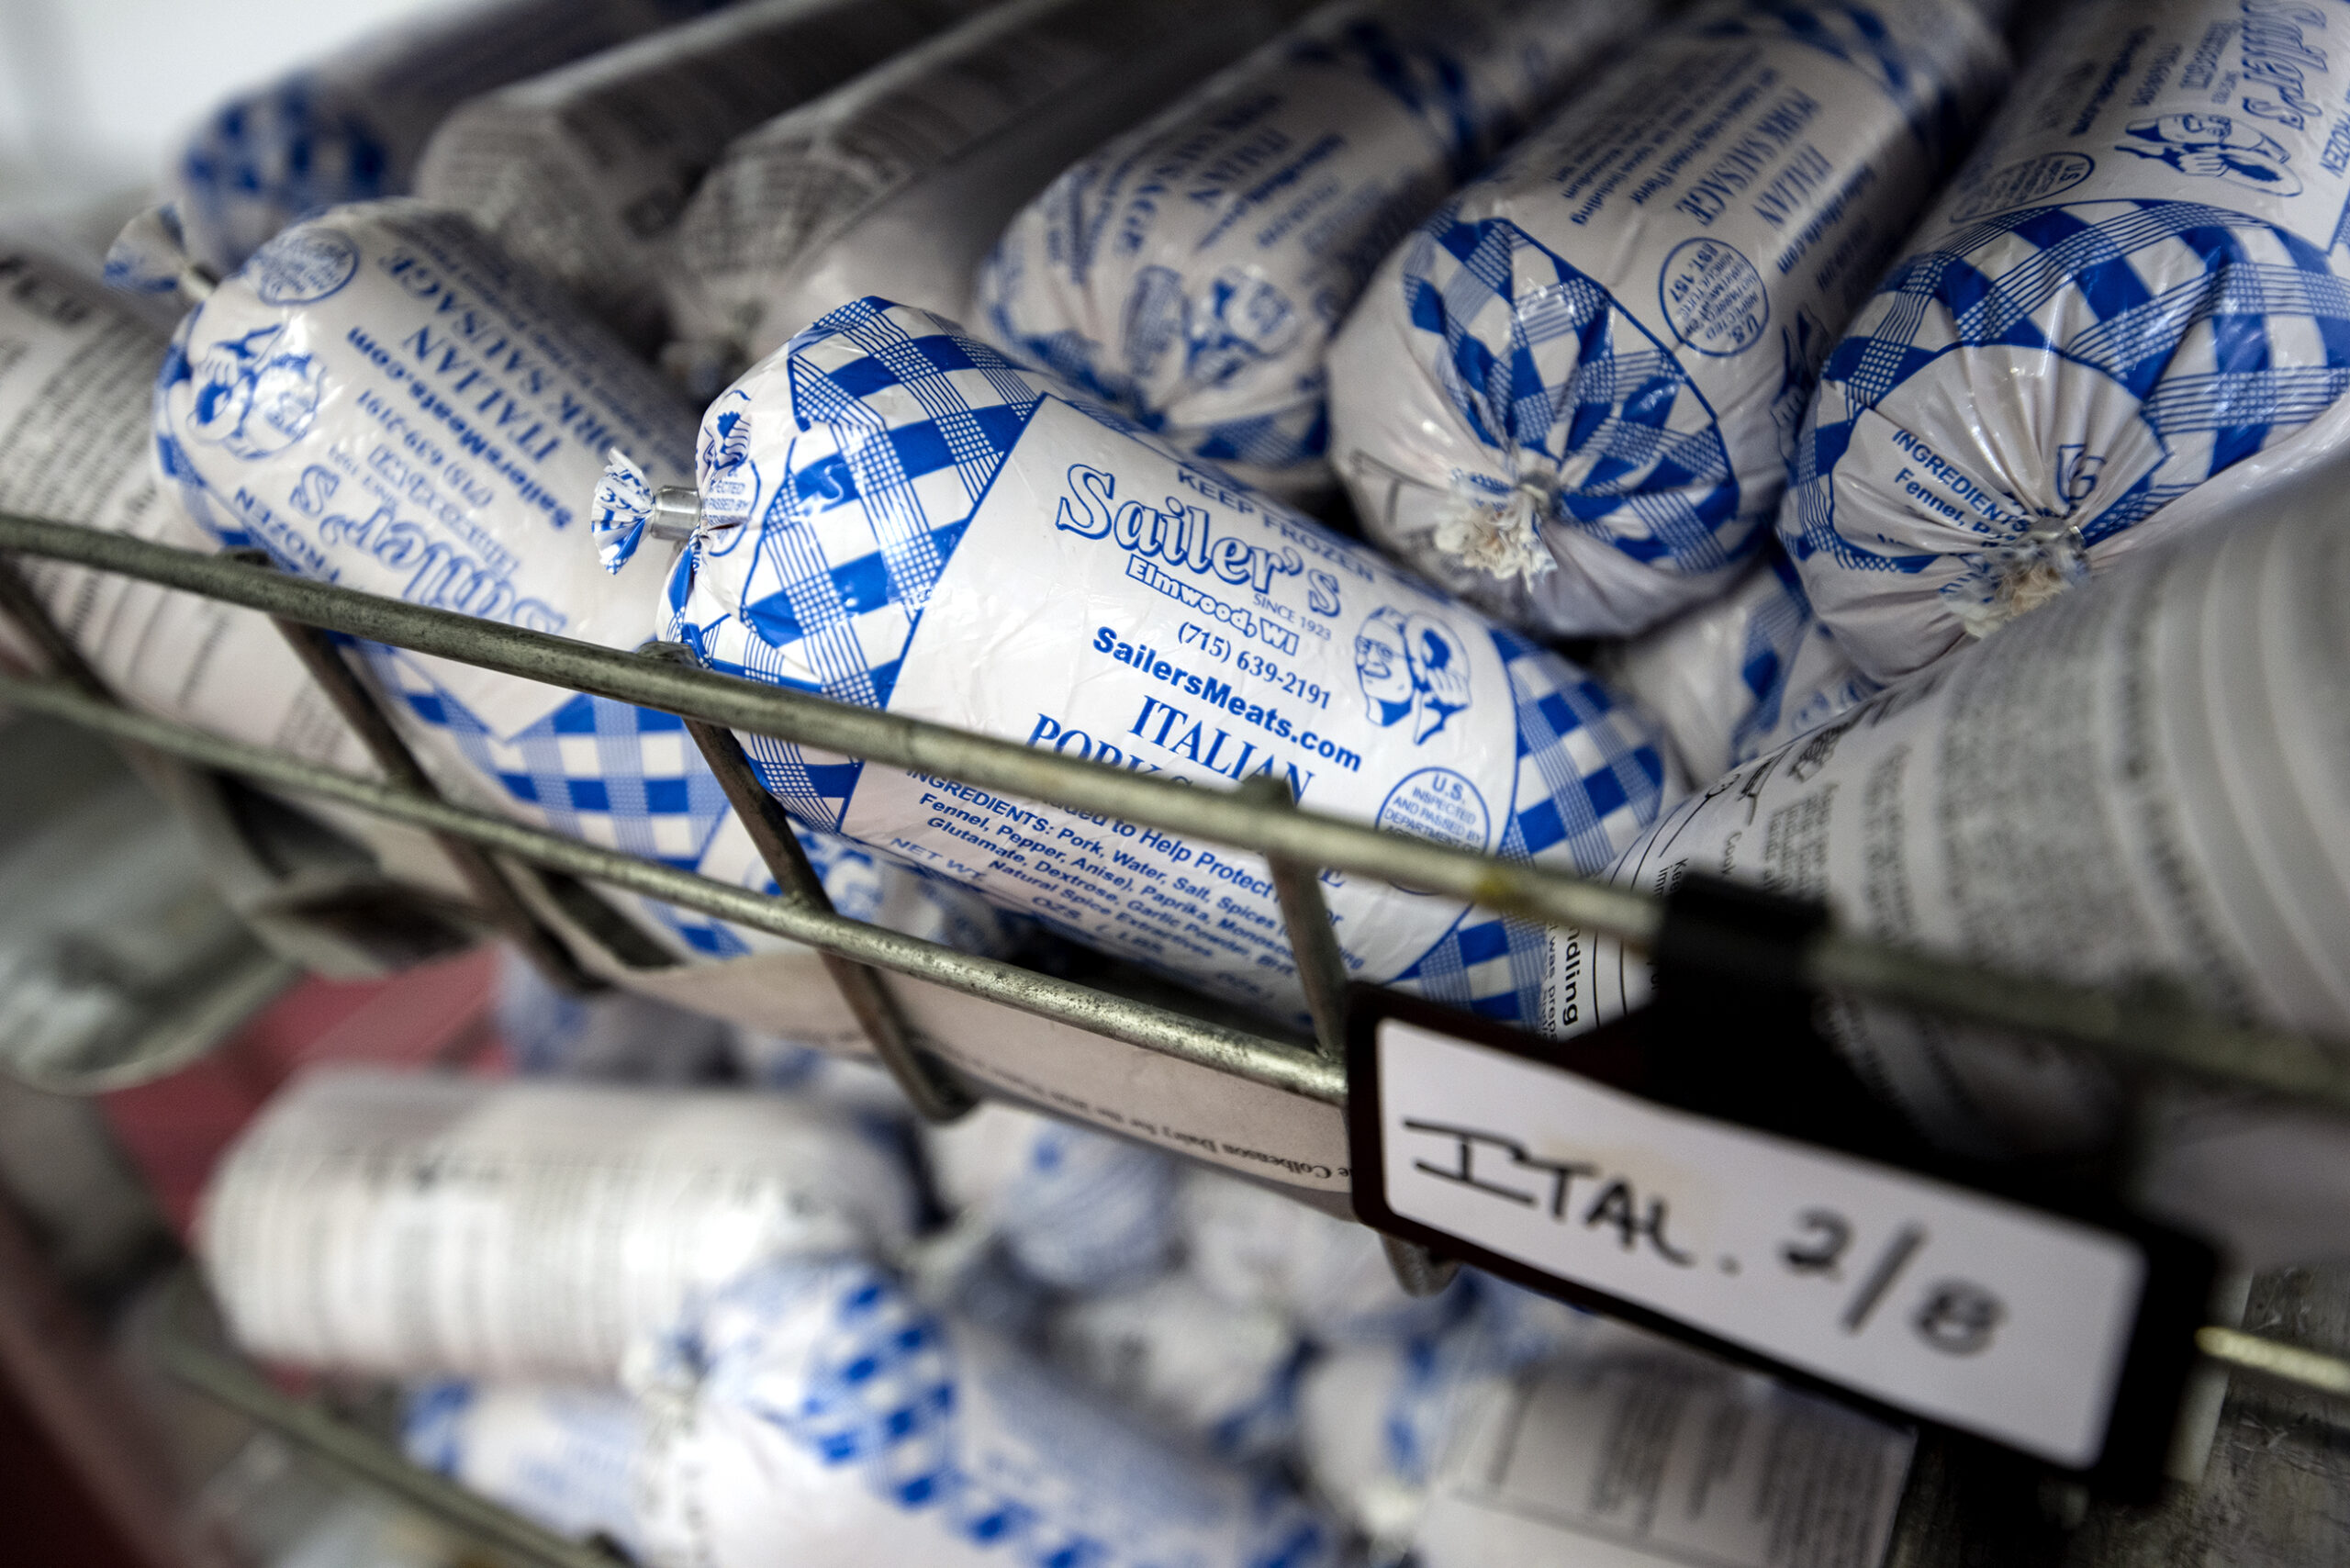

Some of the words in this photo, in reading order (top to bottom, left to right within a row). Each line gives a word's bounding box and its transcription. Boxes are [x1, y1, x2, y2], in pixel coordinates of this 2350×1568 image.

[1673, 136, 1779, 228] SAUSAGE
[1752, 142, 1834, 230] ITALIAN
[377, 246, 555, 398] SAUSAGE
[399, 324, 562, 465] ITALIAN
[1055, 463, 1342, 618] Sailer's
[1177, 468, 1255, 515] KEEP
[1262, 514, 1375, 584] FROZEN
[1894, 467, 1965, 527] Fennel,
[1125, 553, 1258, 638] Elmwood,
[1259, 616, 1300, 657] WI
[1252, 593, 1296, 624] SINCE
[1300, 616, 1333, 642] 1923
[1092, 626, 1362, 772] SailersMeats.com
[1178, 622, 1232, 663] (715)
[1237, 650, 1333, 710] 639-2191
[1126, 694, 1316, 808] ITALIAN
[1432, 774, 1466, 805] U.S.
[906, 769, 1055, 834] INGREDIENTS:
[1057, 827, 1105, 859] Pork,
[1112, 849, 1168, 885] Water,
[1172, 877, 1211, 904] Salt,
[1215, 896, 1276, 930] Spices
[1393, 796, 1419, 815] AND
[1420, 808, 1466, 836] PASSED
[1412, 787, 1477, 825] INSPECTED
[890, 837, 944, 861] NET
[946, 859, 987, 882] WT.
[919, 792, 990, 832] Fennel,
[995, 824, 1068, 864] Pepper,
[1216, 918, 1294, 960] Monosod
[927, 817, 1028, 866] Glutamate,
[1126, 900, 1181, 927] Garlic
[988, 859, 1058, 892] Natural
[1059, 886, 1113, 917] Spice
[1111, 817, 1137, 838] to
[1139, 828, 1192, 864] Help
[1193, 851, 1274, 899] Protect
[1669, 857, 1689, 893] Kee
[1562, 925, 1582, 1026] ndling
[1221, 1143, 1332, 1179] Colbenson
[1402, 1118, 1740, 1276] ITAL.
[1778, 1206, 2009, 1361] 2/8
